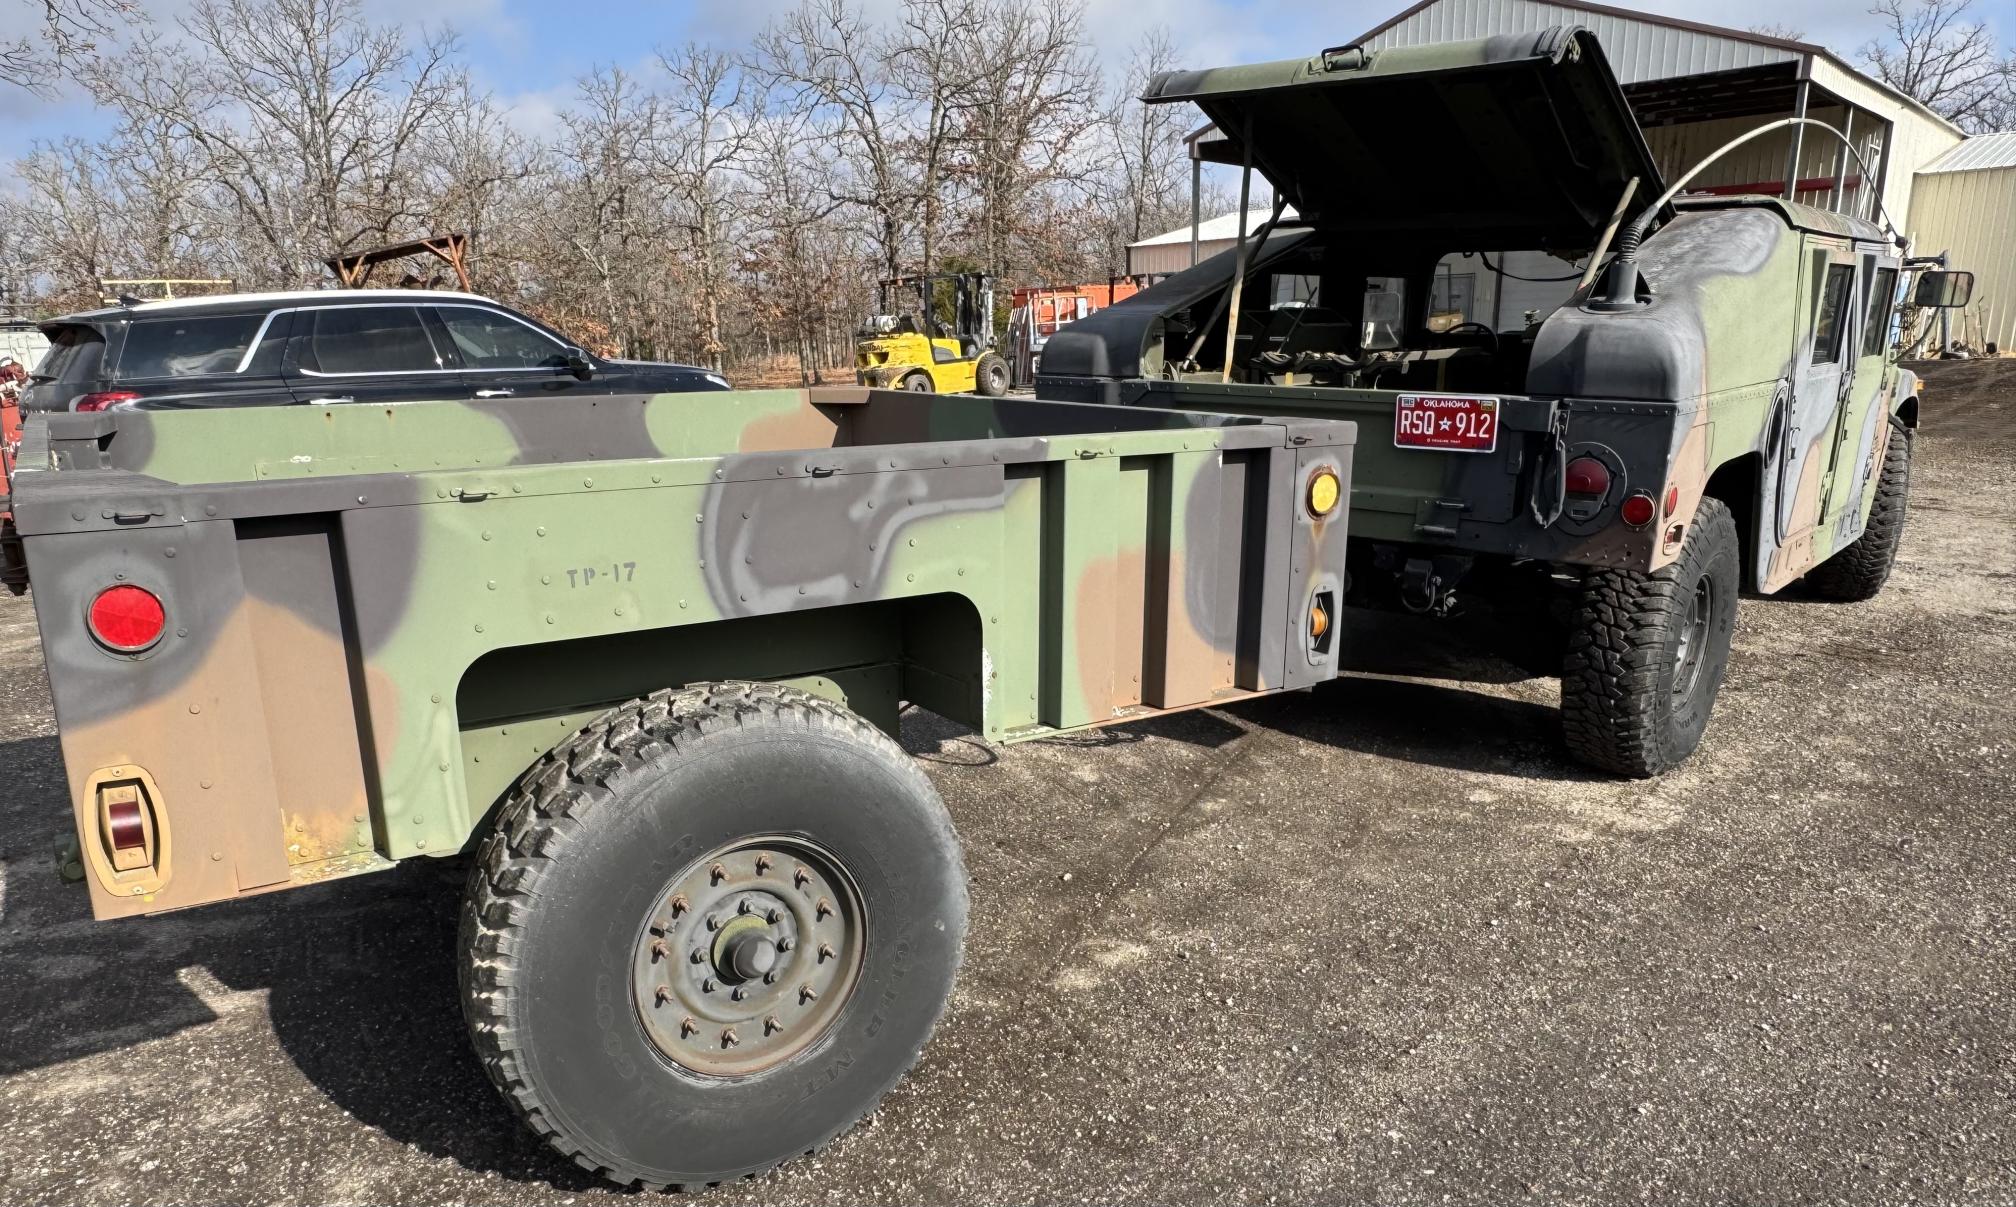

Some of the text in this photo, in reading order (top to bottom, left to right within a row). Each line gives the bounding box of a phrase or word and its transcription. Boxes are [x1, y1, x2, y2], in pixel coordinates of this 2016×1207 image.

[1423, 399, 1470, 409] OKLAHOMA
[1400, 410, 1491, 438] RSQ 912
[566, 561, 636, 589] TP-17
